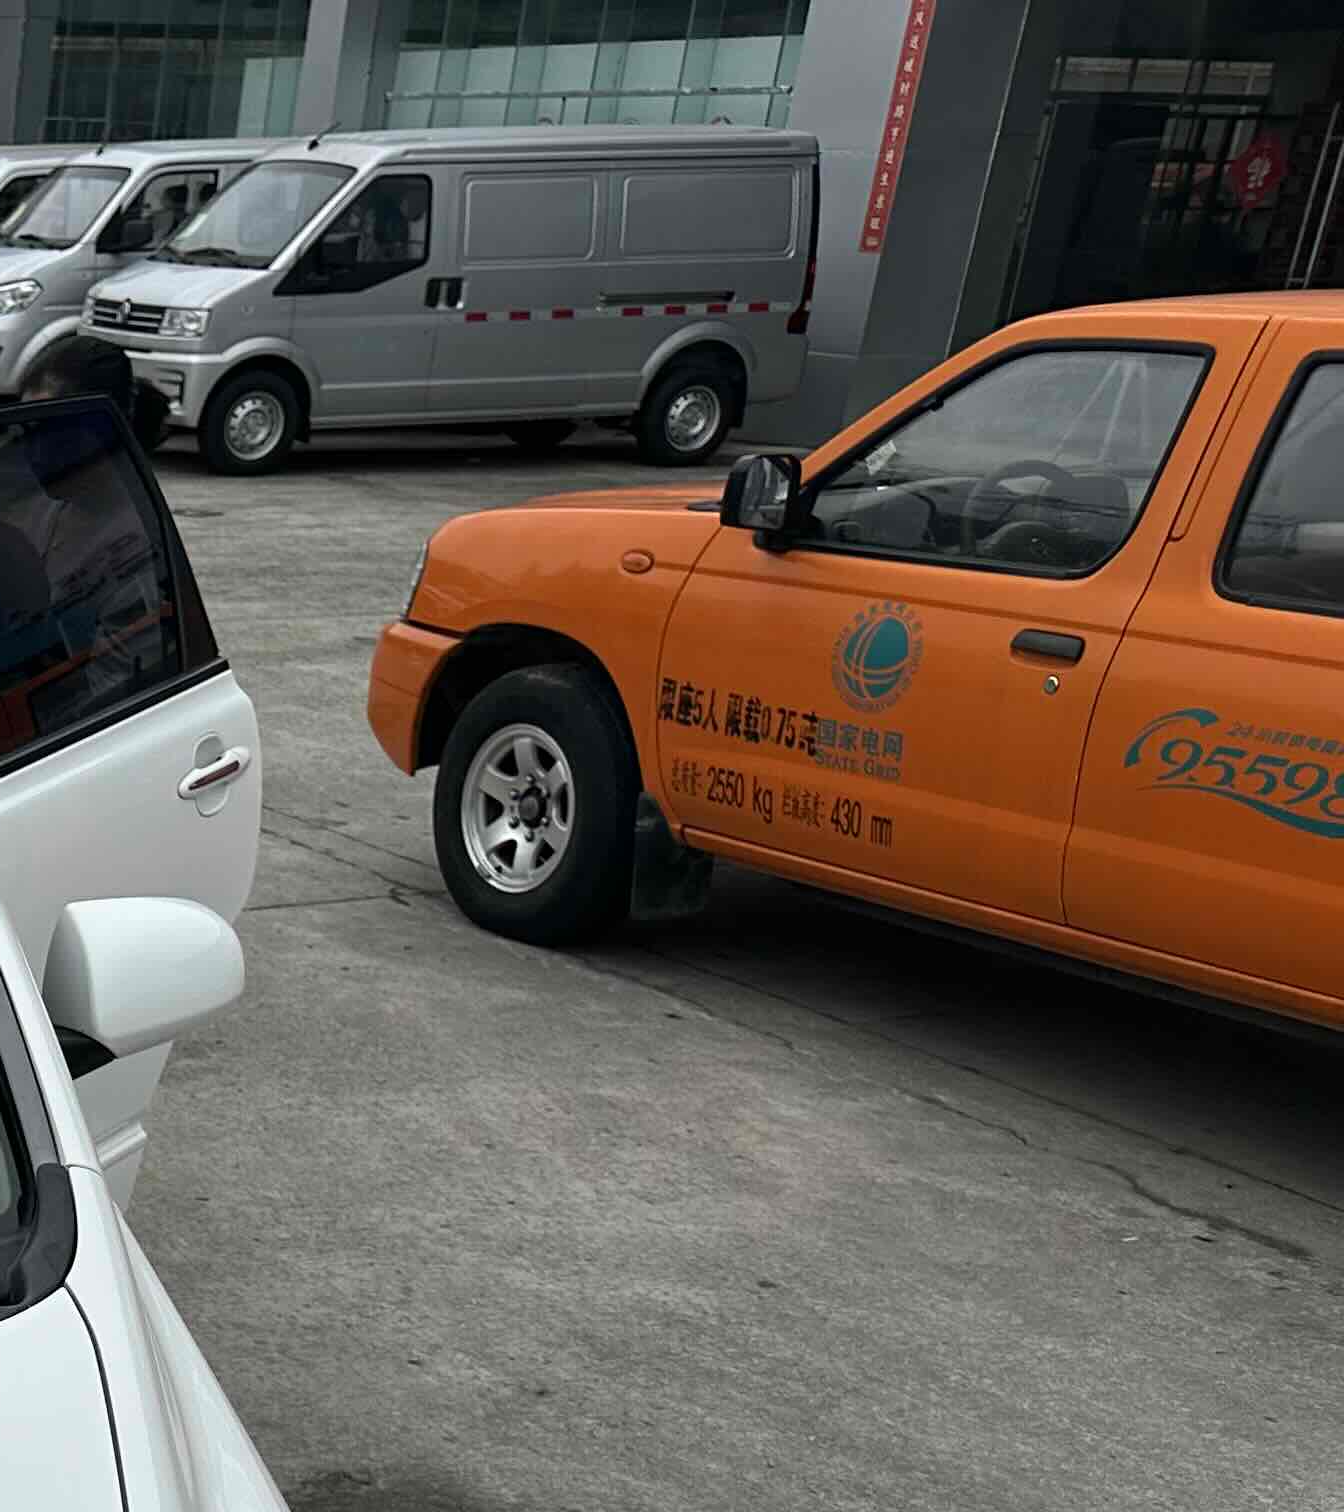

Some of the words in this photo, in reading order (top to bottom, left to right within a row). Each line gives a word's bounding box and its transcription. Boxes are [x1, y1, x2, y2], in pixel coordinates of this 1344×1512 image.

[817, 718, 904, 761] 国家电网
[707, 765, 745, 809] 2550
[752, 775, 774, 825] kg
[830, 796, 862, 839] 430
[870, 814, 894, 849] mm
